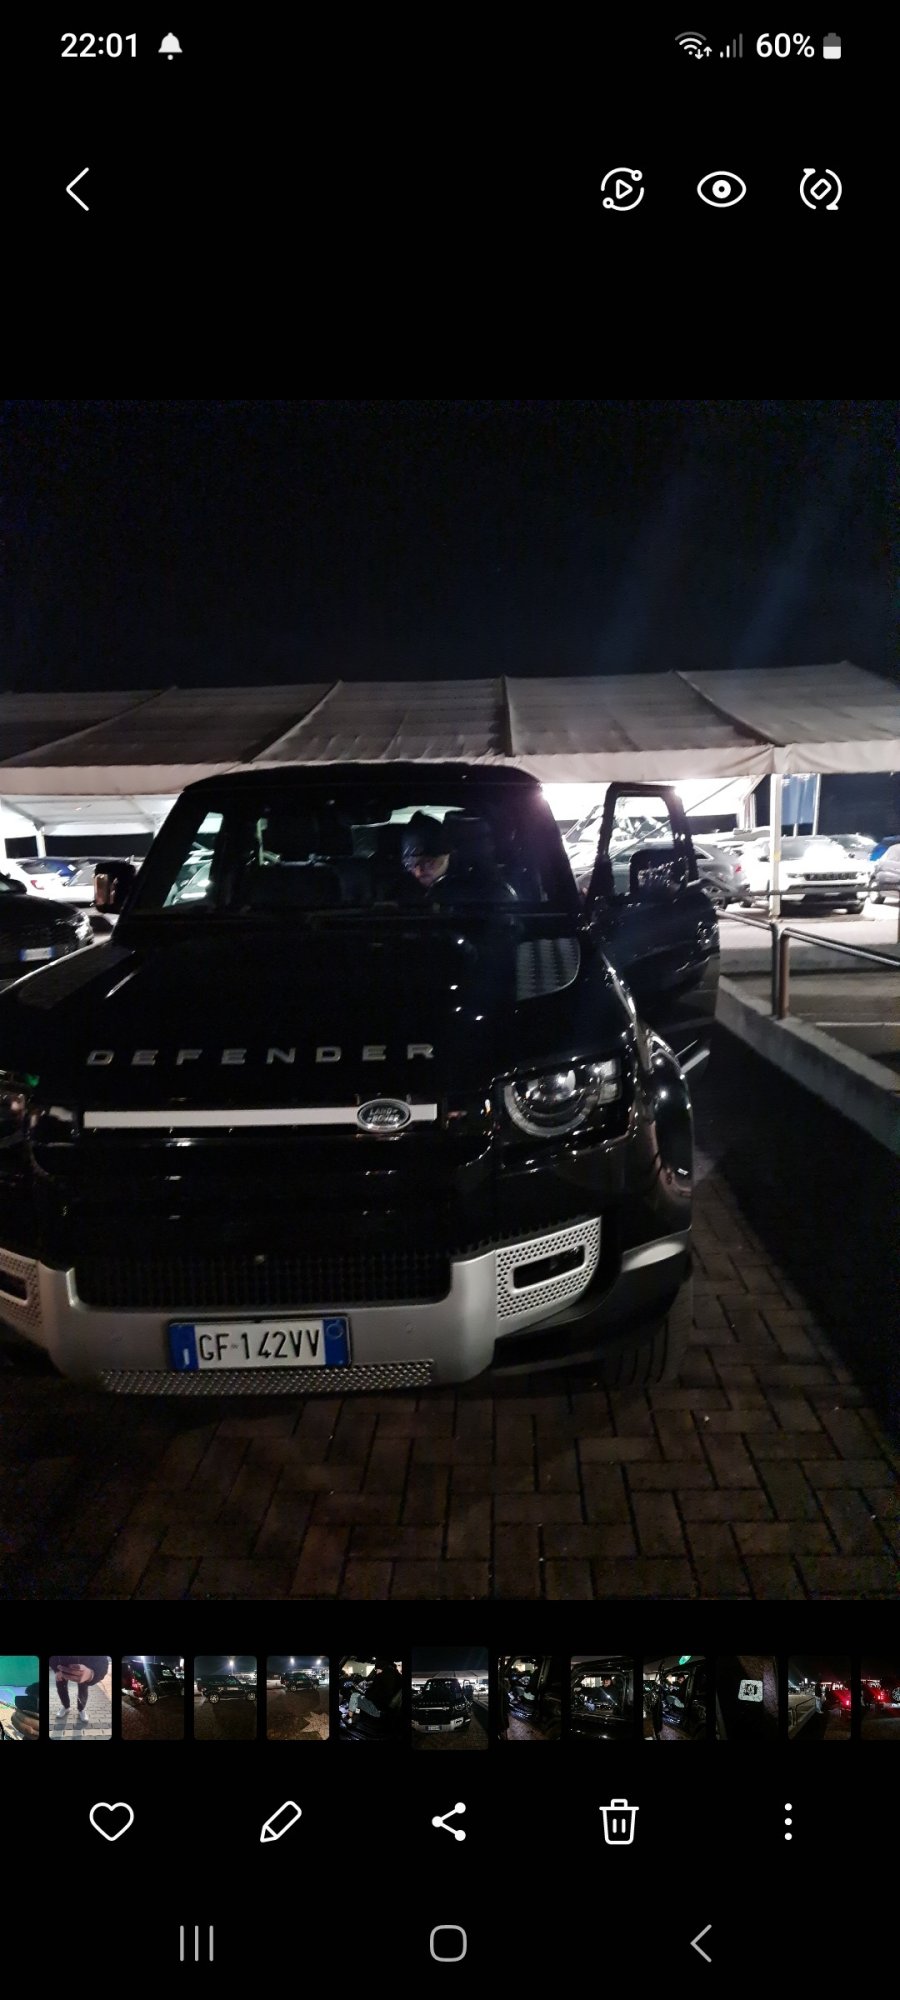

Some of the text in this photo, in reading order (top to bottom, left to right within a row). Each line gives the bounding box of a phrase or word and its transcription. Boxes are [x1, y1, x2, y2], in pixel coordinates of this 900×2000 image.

[60, 32, 138, 58] 22:01
[756, 32, 815, 58] 60%
[86, 1043, 434, 1065] DEFENDER
